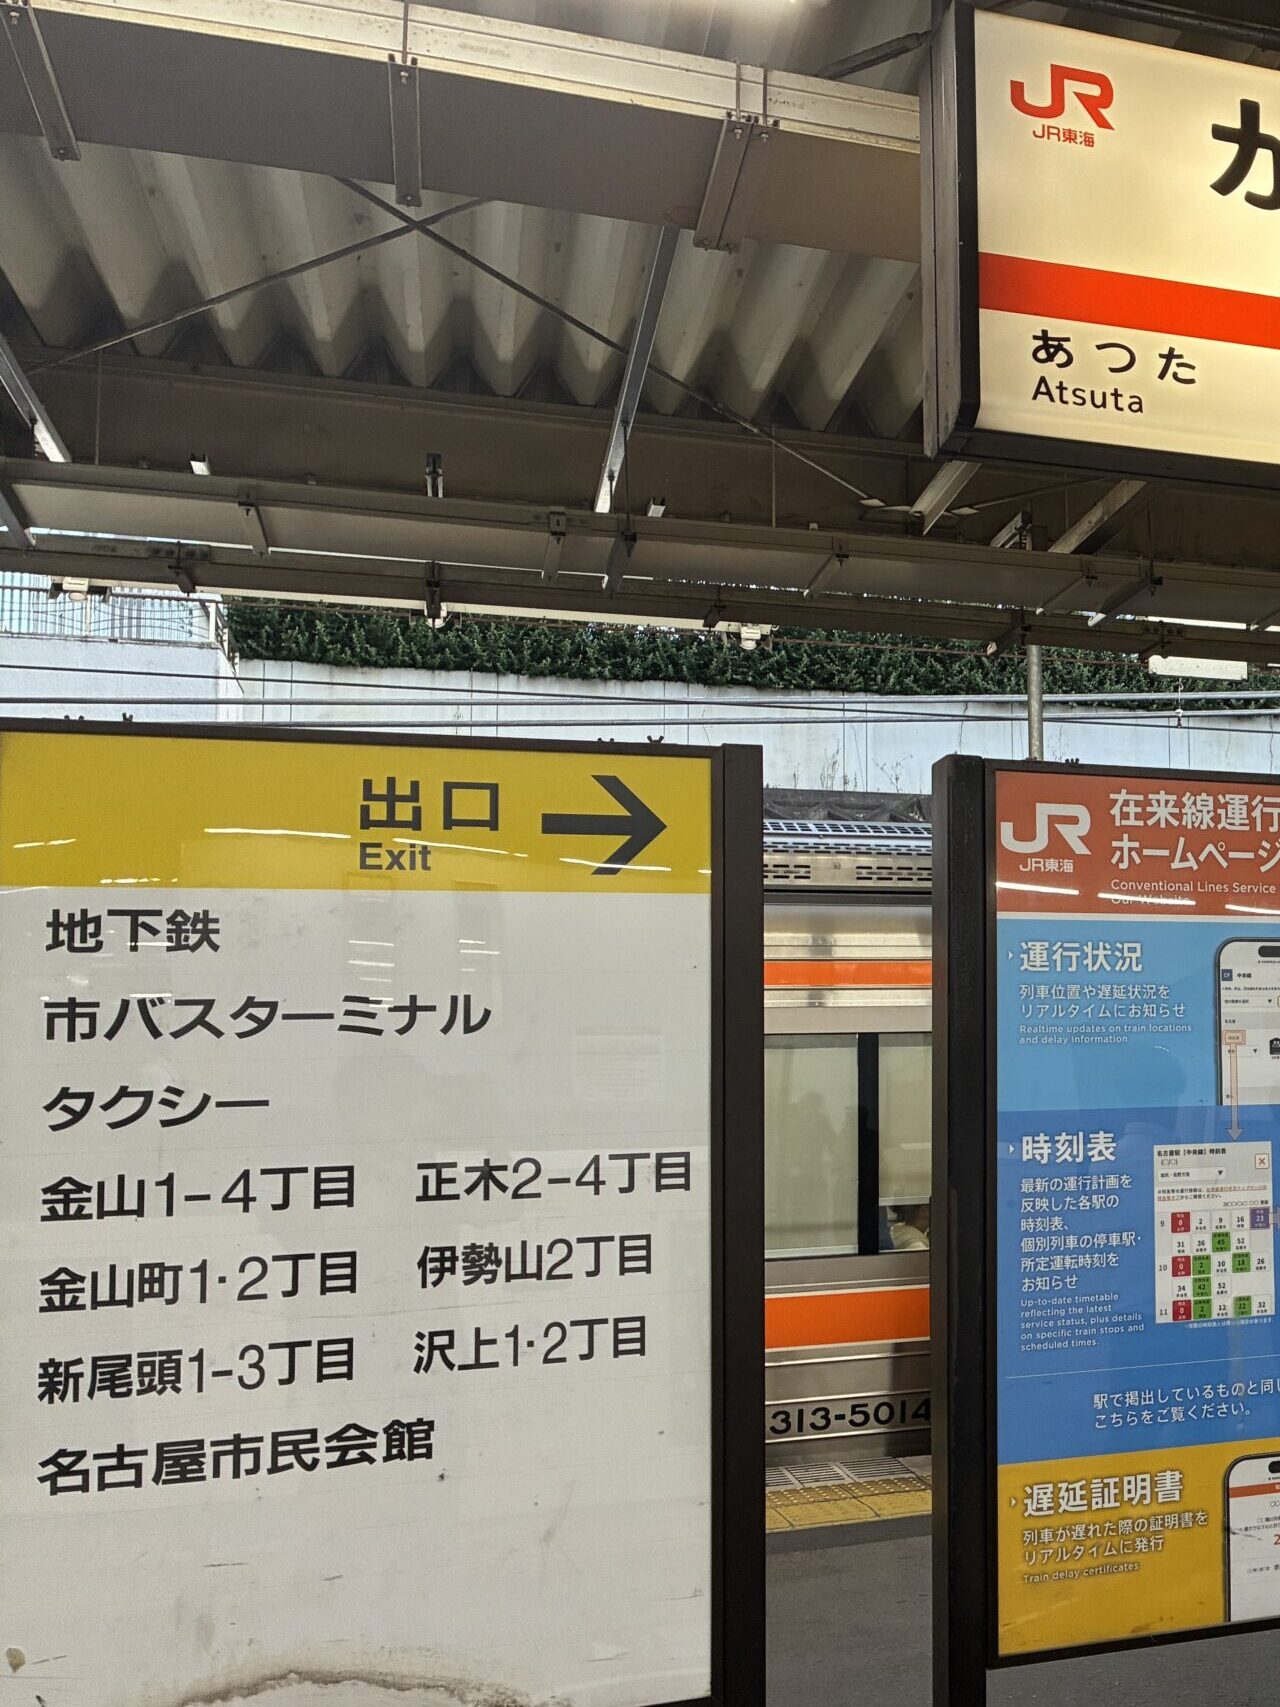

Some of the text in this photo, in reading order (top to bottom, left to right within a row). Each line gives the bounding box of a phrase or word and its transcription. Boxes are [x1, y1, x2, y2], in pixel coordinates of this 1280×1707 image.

[1032, 123, 1096, 148] JR東海
[1031, 329, 1198, 386] あつた
[1032, 375, 1145, 415] Atsuta
[359, 776, 500, 832] 出口
[359, 842, 431, 871] Exit
[1019, 857, 1073, 873] JR東海
[1111, 879, 1194, 893] Conventional
[1197, 882, 1229, 893] Lines
[1232, 883, 1269, 895] Service
[45, 907, 221, 954] 地下鉄
[1020, 941, 1143, 973] 運行状況
[1019, 984, 1170, 1000] 列車位置や遅延状況を
[44, 993, 492, 1043] 市バスターミナル
[1021, 1003, 1186, 1018] リアルタイムにお知らせ
[1020, 1025, 1064, 1034] Realtime
[1067, 1024, 1105, 1034] updates
[1124, 1024, 1146, 1032] train
[1149, 1023, 1192, 1032] locations
[1020, 1034, 1128, 1045] and delay information
[42, 1085, 270, 1132] タクシー
[1021, 1131, 1117, 1165] 時刻表
[1020, 1174, 1133, 1193] 最新の運行計画を
[1020, 1194, 1119, 1213] 反映した各駅の
[1020, 1216, 1069, 1233] 時刻表、
[416, 1233, 653, 1289] 伊勢山2丁目
[1020, 1252, 1119, 1273] 所定運転時刻を
[1021, 1275, 1078, 1292] お知らせ
[1020, 1293, 1119, 1307] Up-to-date timetable
[1020, 1304, 1112, 1318] reflecting the latest
[1020, 1320, 1054, 1329] service
[1090, 1314, 1110, 1325] plus
[1112, 1312, 1142, 1322] details
[1036, 1328, 1072, 1340] specific
[1075, 1327, 1097, 1336] train
[1099, 1325, 1125, 1335] stops
[1127, 1323, 1145, 1332] and
[1020, 1340, 1069, 1351] scheduled
[769, 1398, 931, 1435] 313-5014
[1095, 1402, 1250, 1429] こちらをご覧ください。
[36, 1416, 436, 1497] 名古屋市民会館
[1024, 1470, 1183, 1517] 遅延証明書
[1023, 1511, 1208, 1546] 列車が遅れた際の証明書を
[1024, 1534, 1164, 1566] リアルタイムに発行
[1023, 1562, 1139, 1583] Train delay certificates
